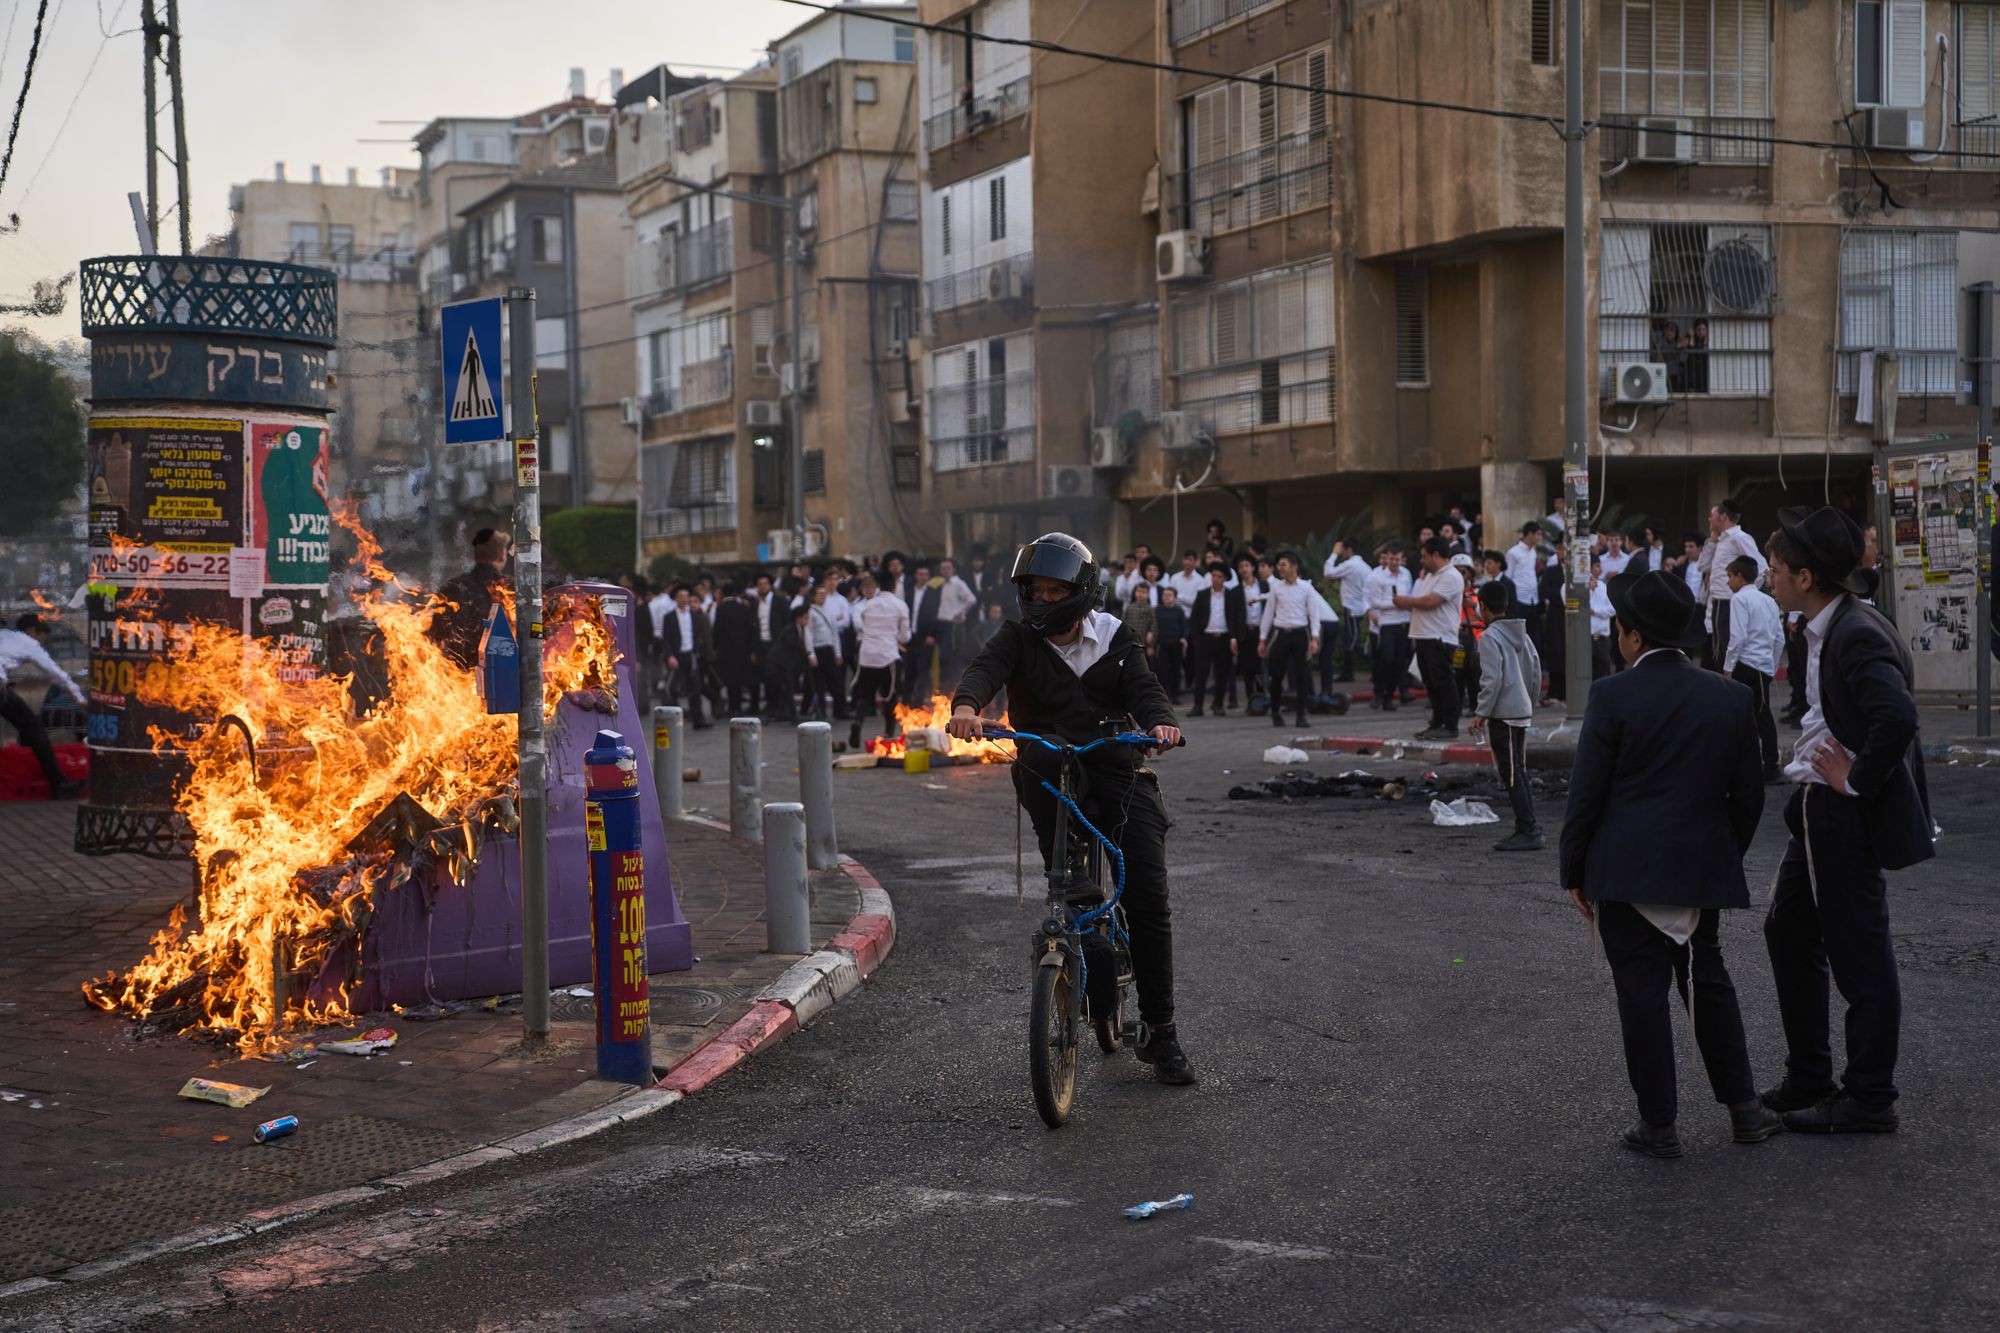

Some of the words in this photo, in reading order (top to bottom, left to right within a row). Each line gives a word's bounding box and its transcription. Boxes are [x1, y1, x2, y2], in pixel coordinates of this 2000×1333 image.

[94, 342, 171, 380] עיריי
[207, 344, 283, 392] ברק
[160, 449, 184, 460] גלאי
[187, 449, 222, 461] שמעון
[149, 466, 172, 479] יוסף
[174, 467, 212, 479] חזקיהו
[165, 478, 226, 491] מישקובסקי
[617, 875, 639, 891] בטוח
